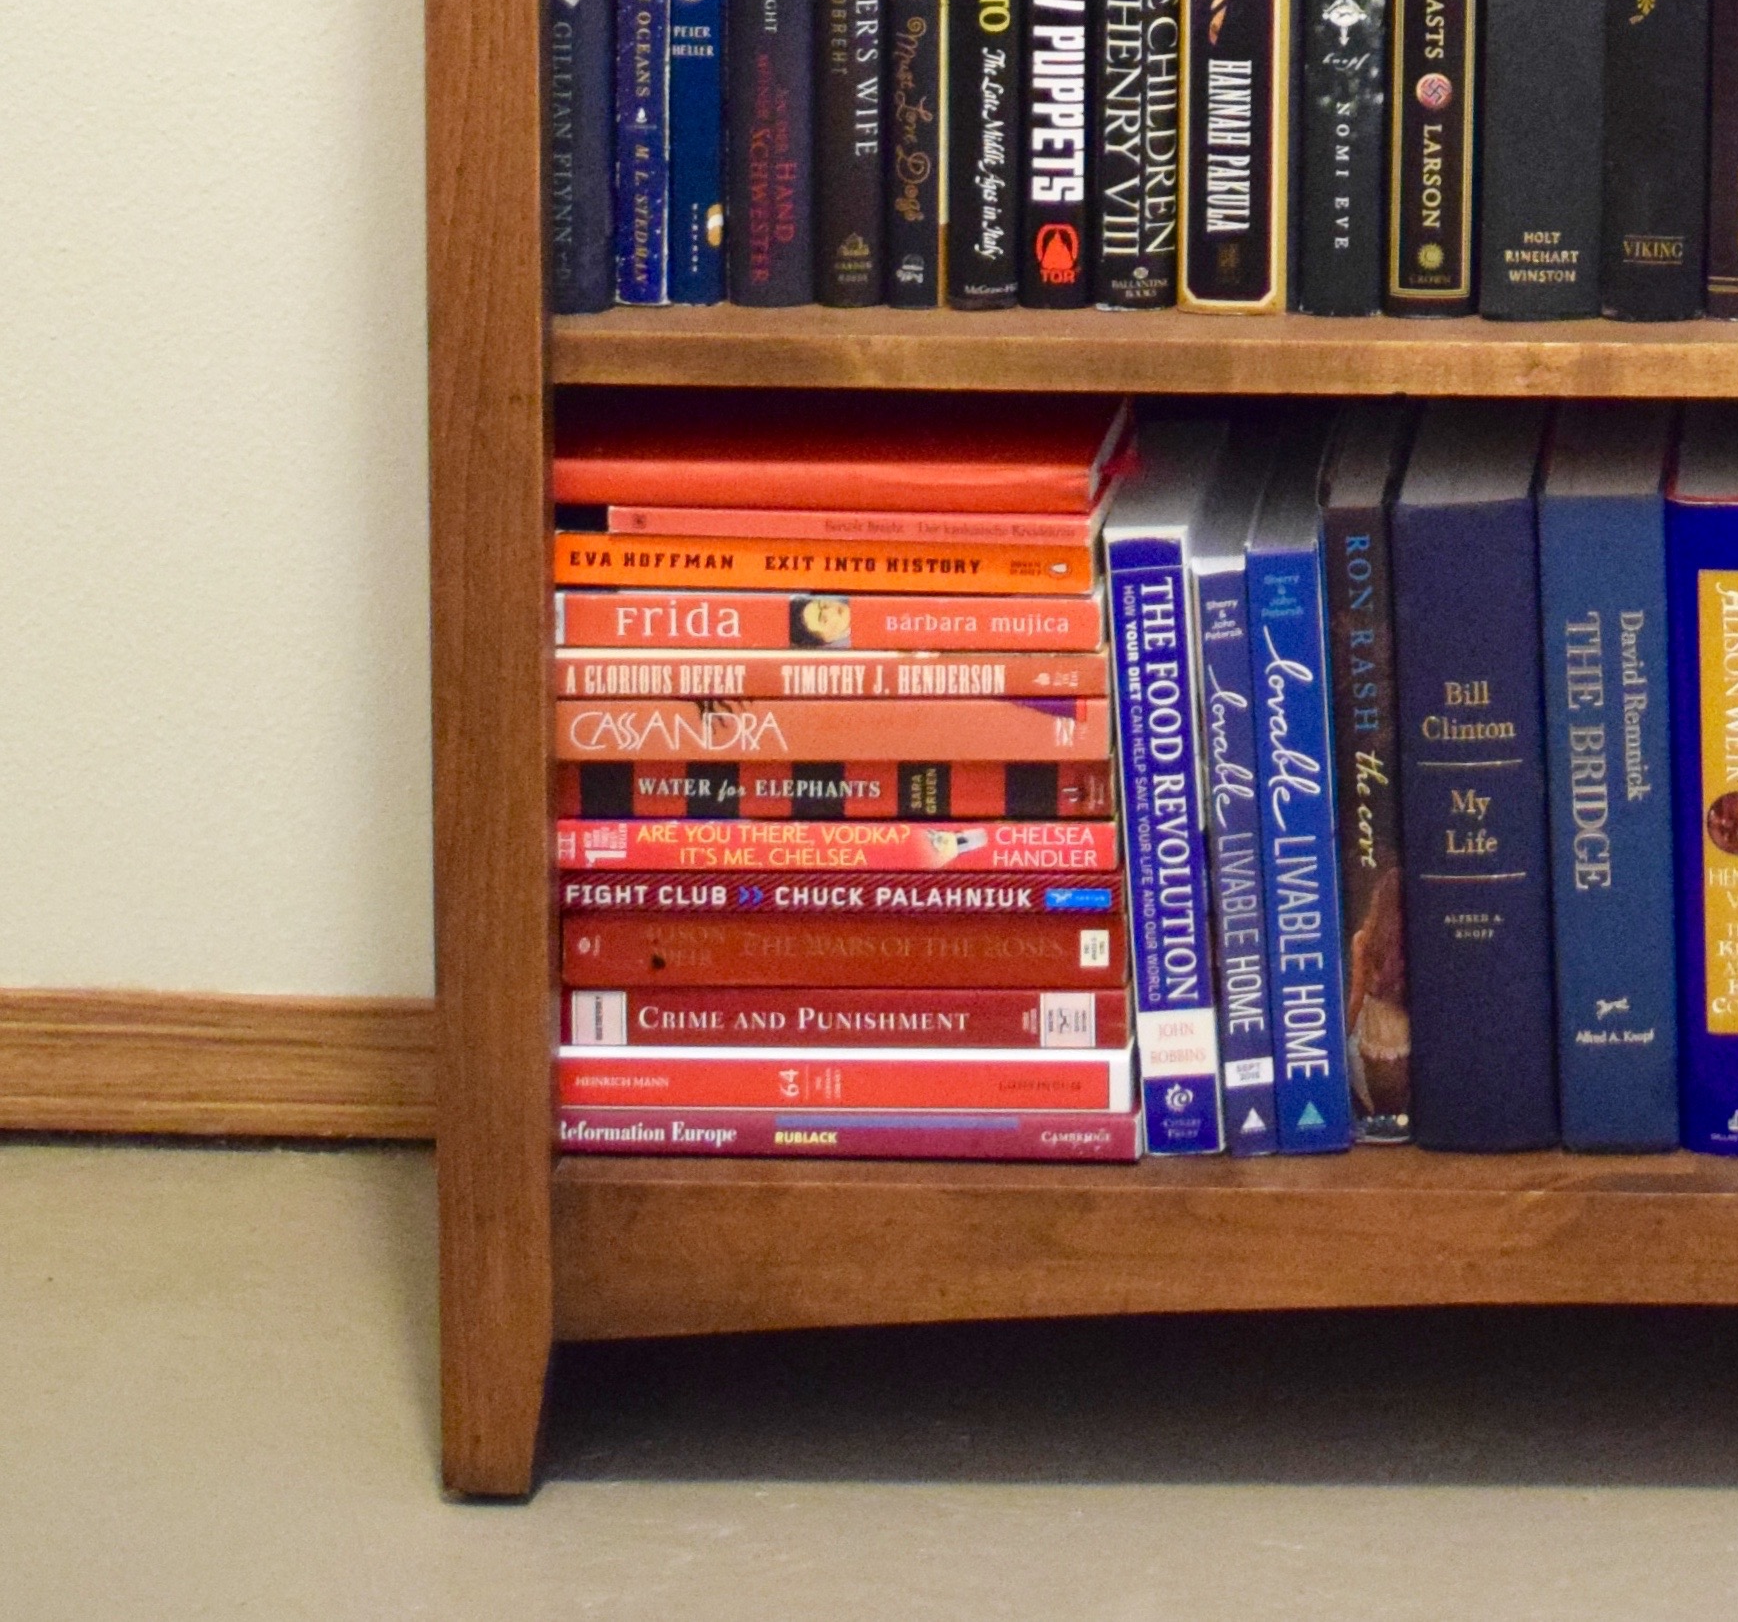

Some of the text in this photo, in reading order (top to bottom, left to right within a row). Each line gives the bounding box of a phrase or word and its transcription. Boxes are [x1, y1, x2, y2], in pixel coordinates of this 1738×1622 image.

[1031, 26, 1084, 203] PUPPETS
[1142, 17, 1178, 254] CHILDREN
[1206, 59, 1253, 233] HANNAH PAKULA
[1102, 160, 1139, 257] VIII
[1040, 269, 1077, 283] TOR
[616, 602, 742, 637] Frida
[1444, 681, 1490, 706] Bill
[570, 711, 788, 753] CASSANDRA
[1422, 716, 1516, 741] Clinton
[1141, 576, 1198, 1002] THE FOOD REVOLUTION
[1451, 790, 1491, 820] My
[1446, 830, 1498, 854] Life
[566, 885, 1033, 909] FIGHT CLUB CHUCK PALAHNIUK
[1273, 836, 1328, 1078] LIVABLE HOME
[639, 1006, 970, 1032] CRIME AND PUNISHMENT
